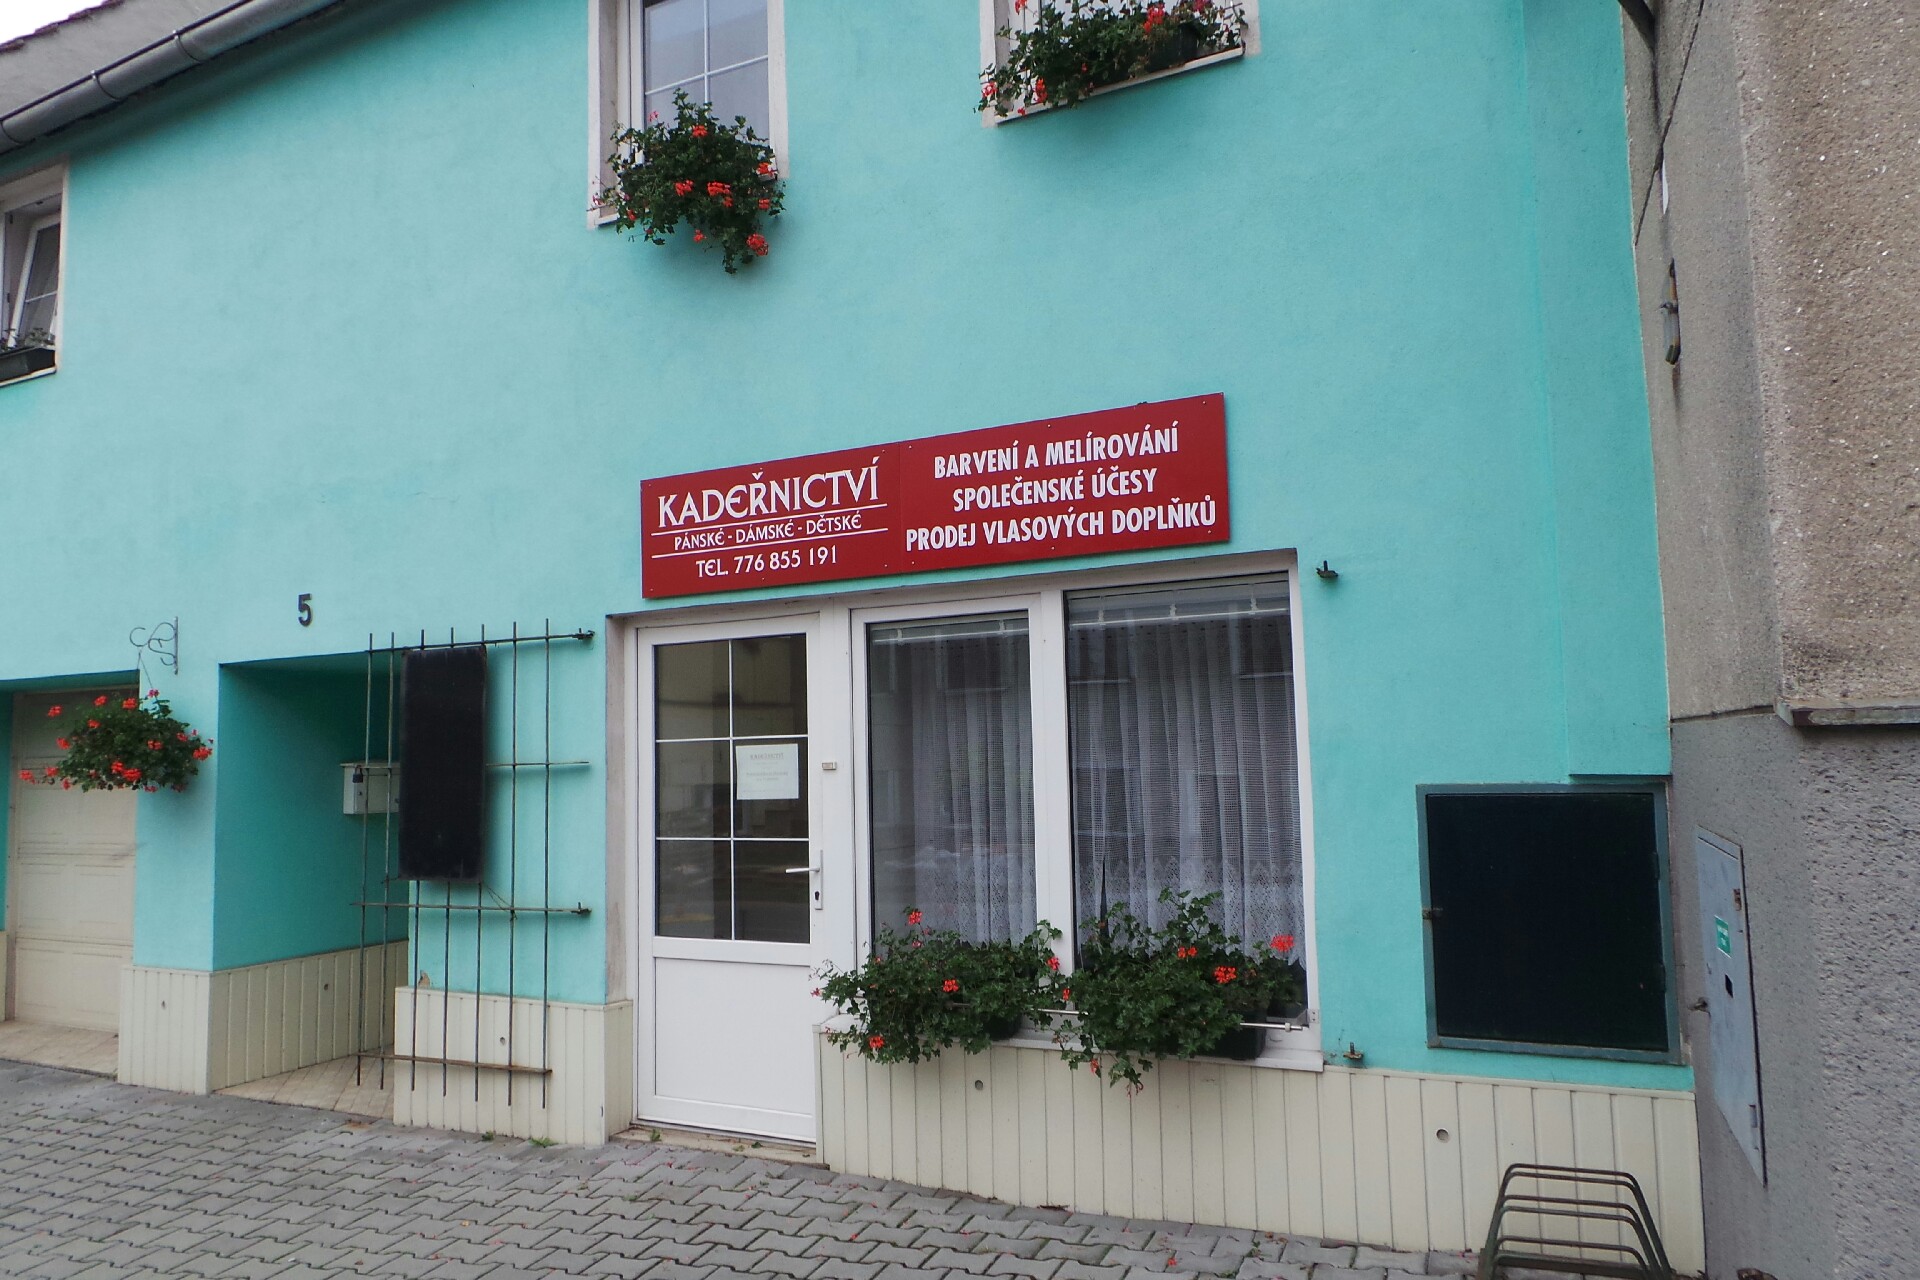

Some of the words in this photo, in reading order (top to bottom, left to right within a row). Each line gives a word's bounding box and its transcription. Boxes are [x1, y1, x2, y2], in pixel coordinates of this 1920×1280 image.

[934, 440, 1019, 479] BARVENÍ
[1024, 444, 1039, 469] A
[1045, 420, 1179, 466] MELÍROVÁNÍ
[658, 456, 880, 528] KADEŘNICTVÍ
[953, 469, 1084, 512] SPOLEČENSKÉ
[1091, 465, 1157, 498] ÚČESY
[674, 528, 725, 551] PÁNSKÉ
[735, 519, 794, 544] DÁMSKÉ
[806, 511, 862, 533] DĚTSKÉ
[906, 522, 976, 552] PRODEJ
[982, 506, 1104, 546] VLASOVÝCH
[1112, 494, 1216, 535] DOPLŇKŮ
[696, 557, 729, 578] TEL.
[733, 553, 765, 574] 776
[769, 549, 801, 570] 855
[809, 544, 837, 566] 191
[298, 593, 312, 627] 5
